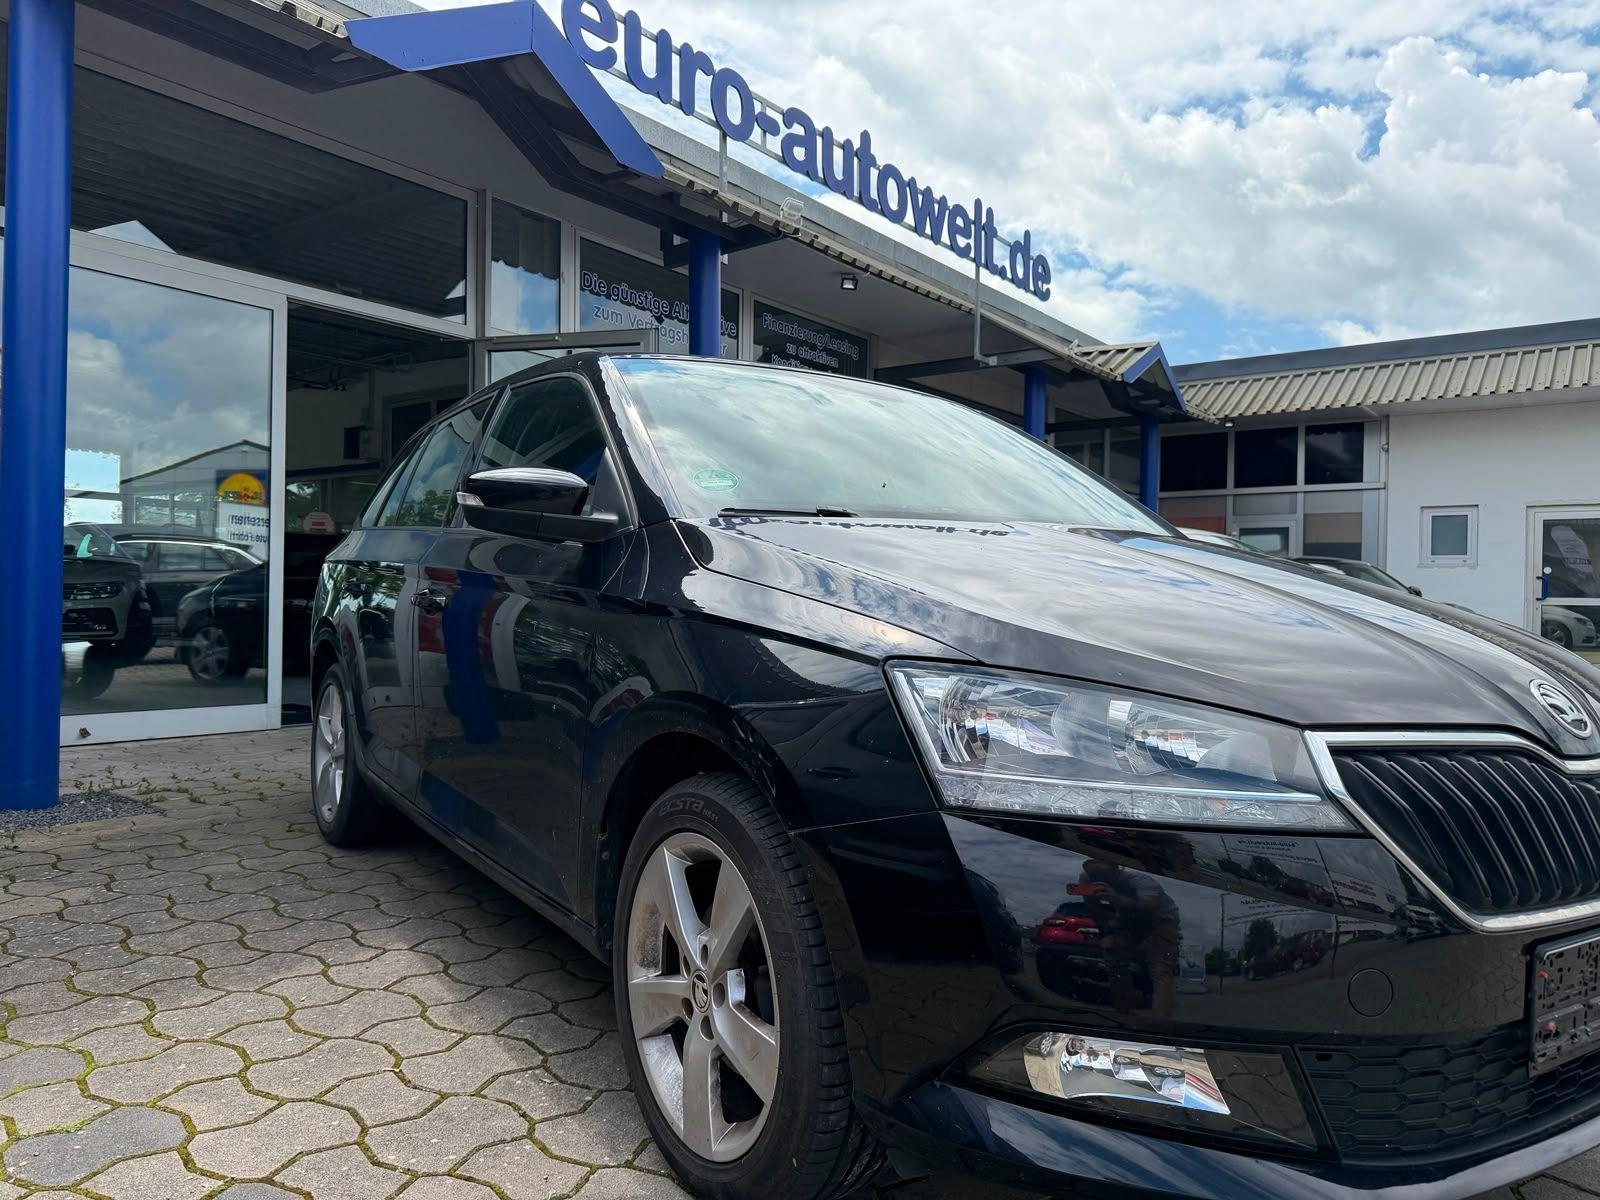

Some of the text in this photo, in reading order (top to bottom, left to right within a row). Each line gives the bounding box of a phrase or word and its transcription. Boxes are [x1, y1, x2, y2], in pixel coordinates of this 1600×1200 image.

[561, 0, 1051, 301] euro-autowelt.de
[581, 270, 607, 295] Die
[610, 282, 669, 317] günstige
[592, 303, 623, 325] zum
[762, 312, 860, 361] Finanzierung/Leasing
[785, 342, 797, 356] zu
